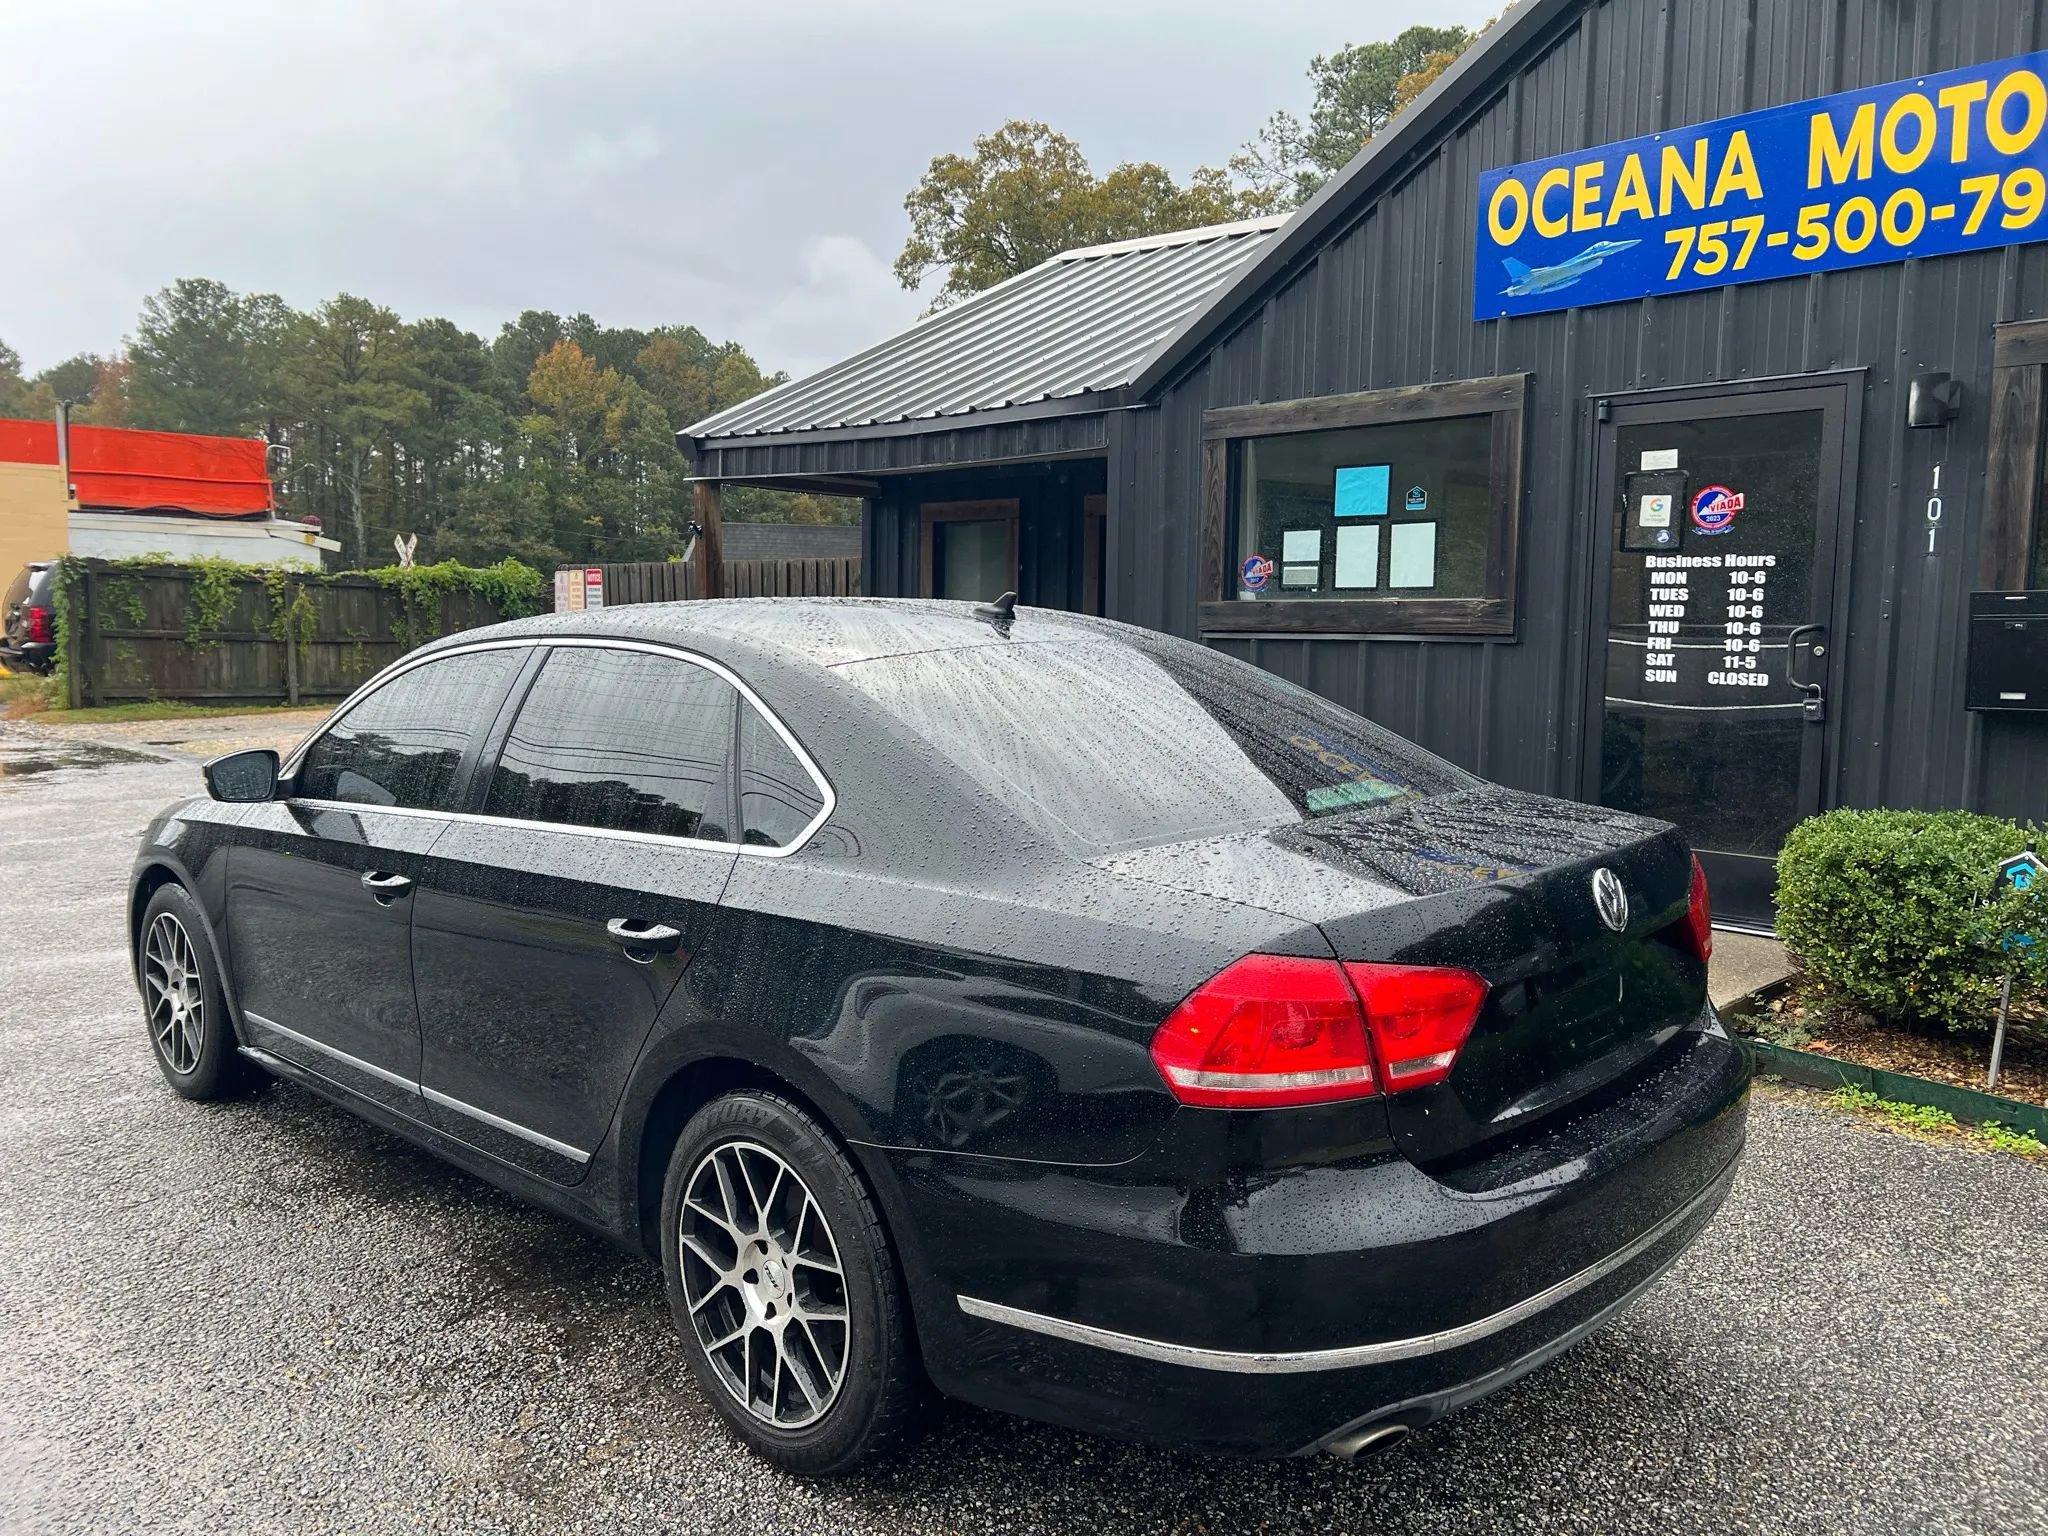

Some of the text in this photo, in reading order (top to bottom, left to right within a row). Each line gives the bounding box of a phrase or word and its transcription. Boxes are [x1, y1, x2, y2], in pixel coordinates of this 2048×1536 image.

[1488, 129, 1763, 246] OCEANA
[1665, 166, 2047, 280] 757-500-79
[1710, 496, 1741, 512] VIADA
[1926, 464, 1942, 553] 101
[1645, 553, 1776, 568] Business Hours
[1650, 570, 1767, 585] MON 10-6
[1649, 587, 1765, 602] TUES 10-6
[1648, 604, 1764, 619] WED 10-6
[1647, 620, 1762, 636] THU 10-6
[1646, 637, 1761, 653] FRI 10-6
[1645, 652, 1757, 670] SAT 11-5
[1644, 668, 1769, 687] SUN CLOSED
